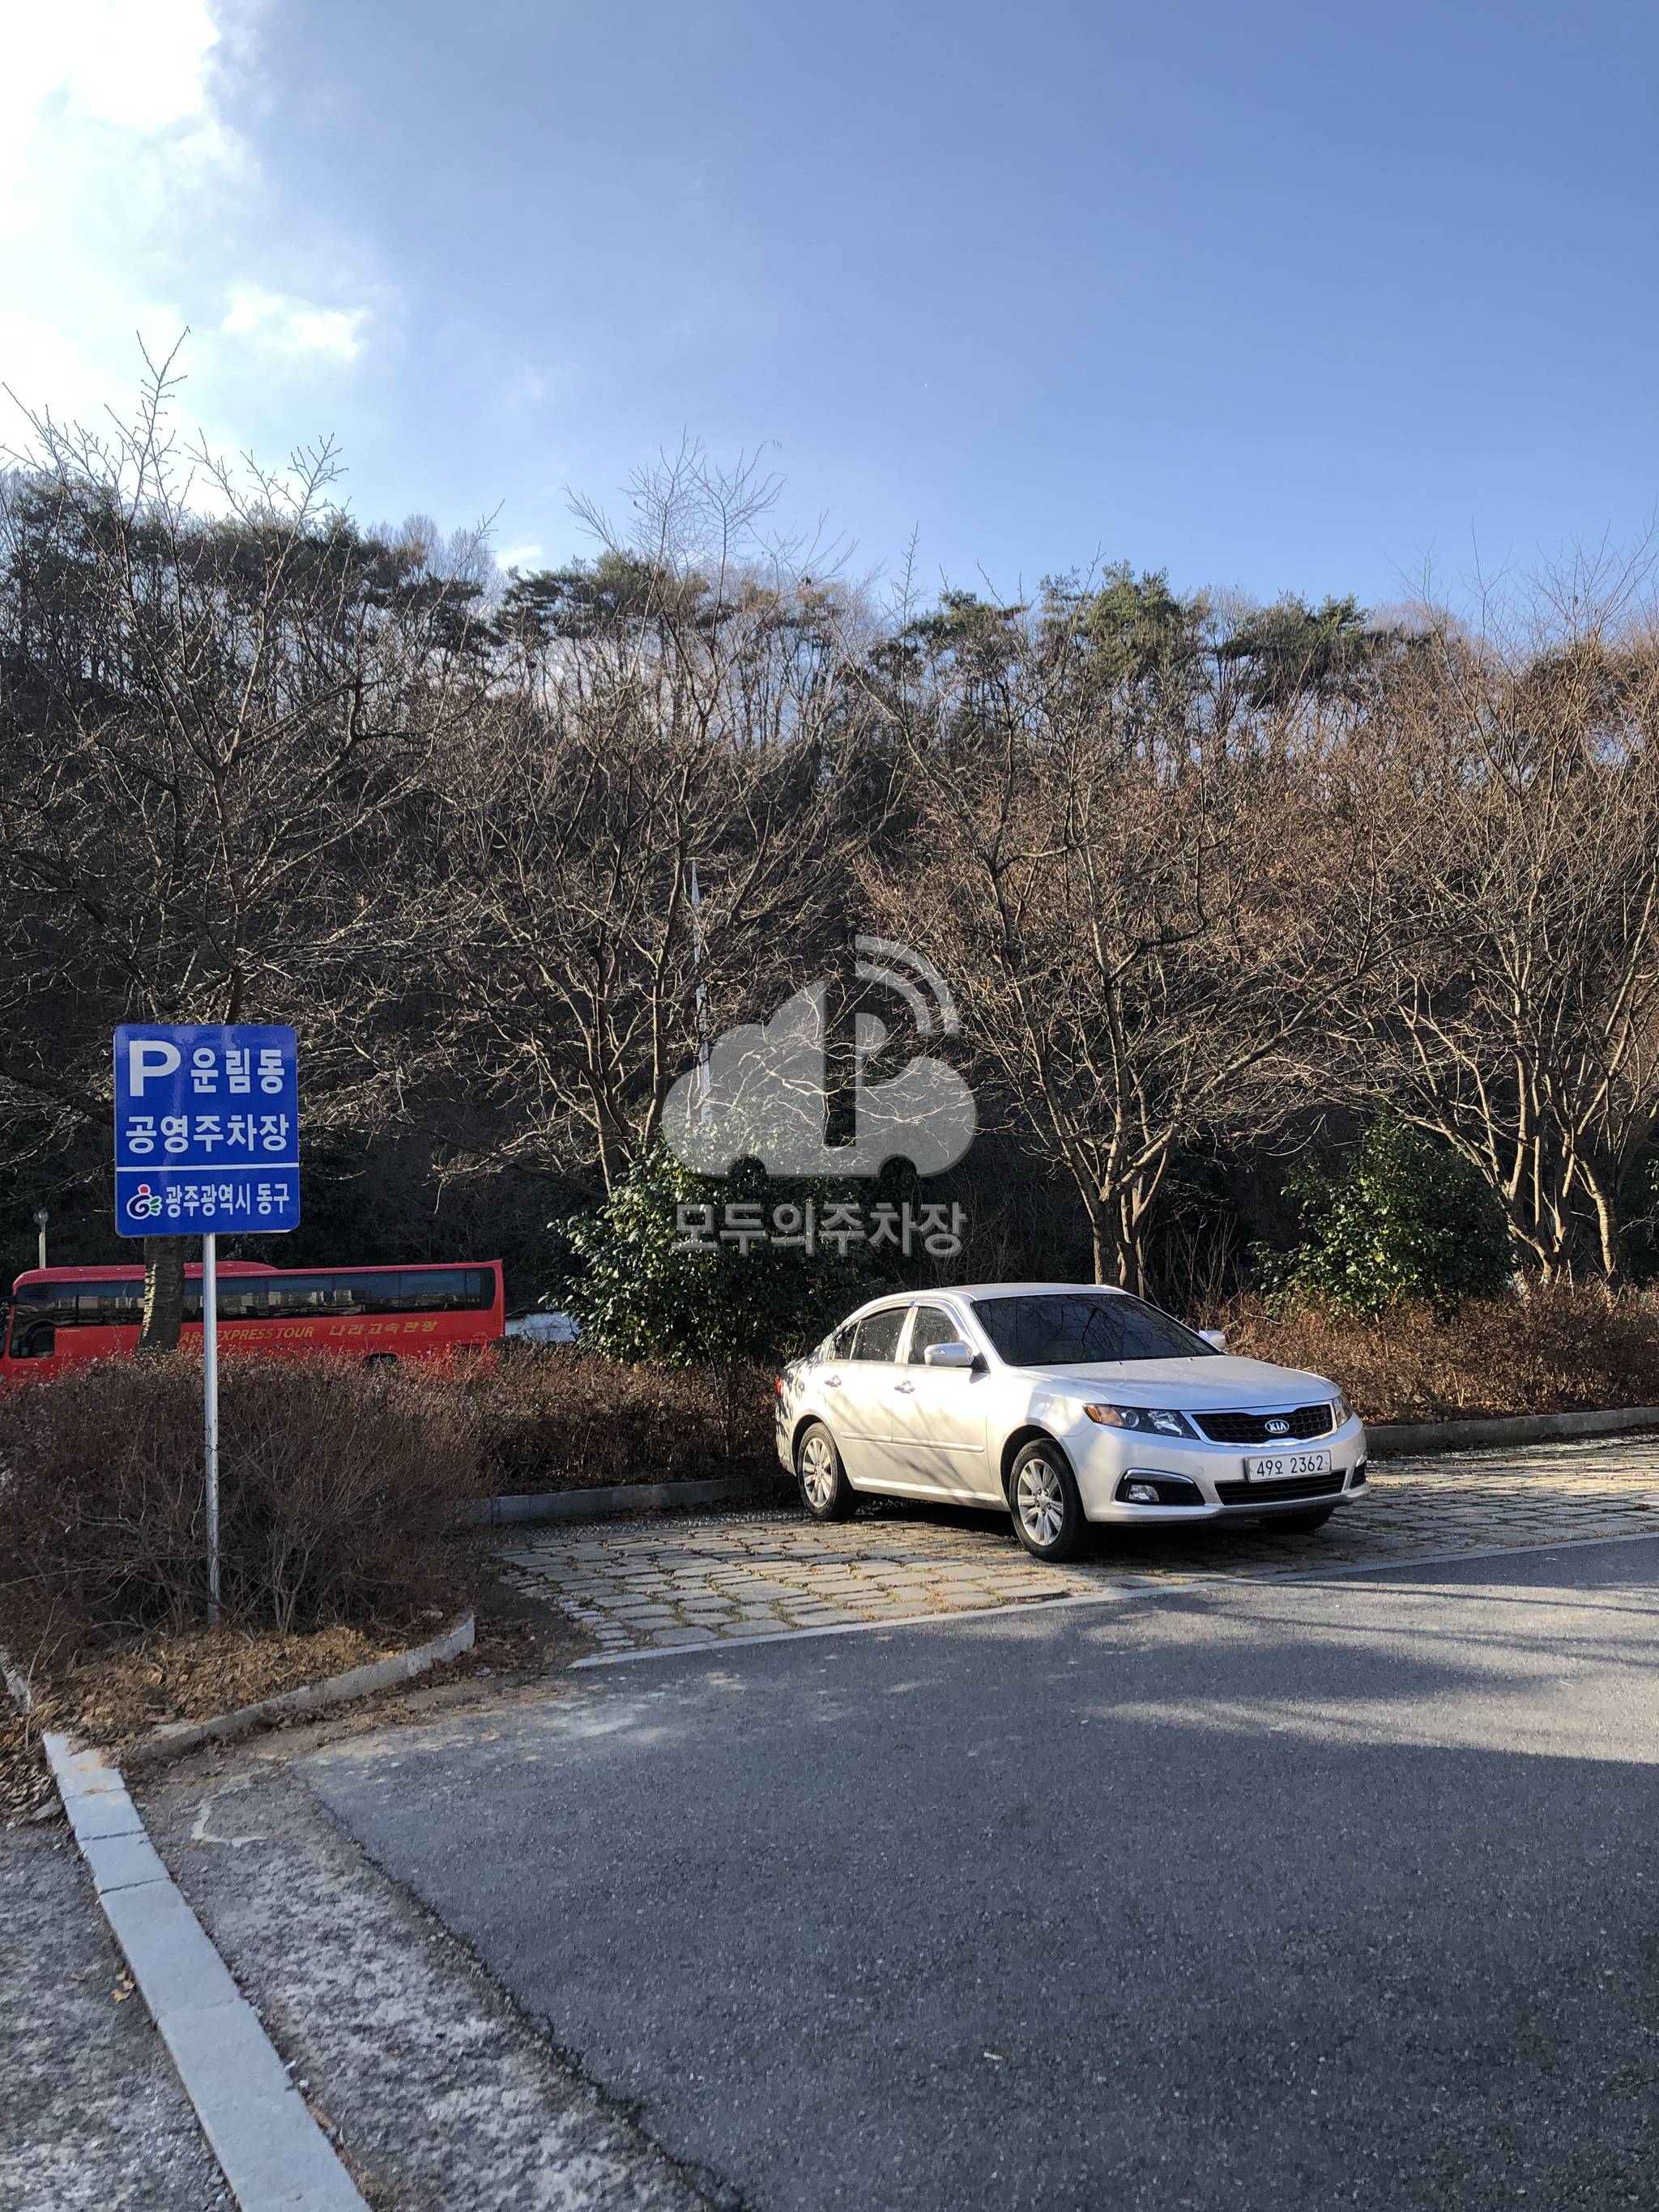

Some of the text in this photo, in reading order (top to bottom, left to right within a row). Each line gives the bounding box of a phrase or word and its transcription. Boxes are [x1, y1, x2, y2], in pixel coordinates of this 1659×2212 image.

[129, 1040, 181, 1097] P
[190, 1047, 285, 1094] 운림동
[126, 1114, 290, 1154] 공영주차장
[165, 1183, 290, 1218] 광주광역시 동구
[216, 1328, 274, 1342] EXPRESS
[276, 1326, 315, 1339] TOUR
[1269, 1422, 1287, 1432] KIA
[1256, 1455, 1324, 1477] 49오 2362
